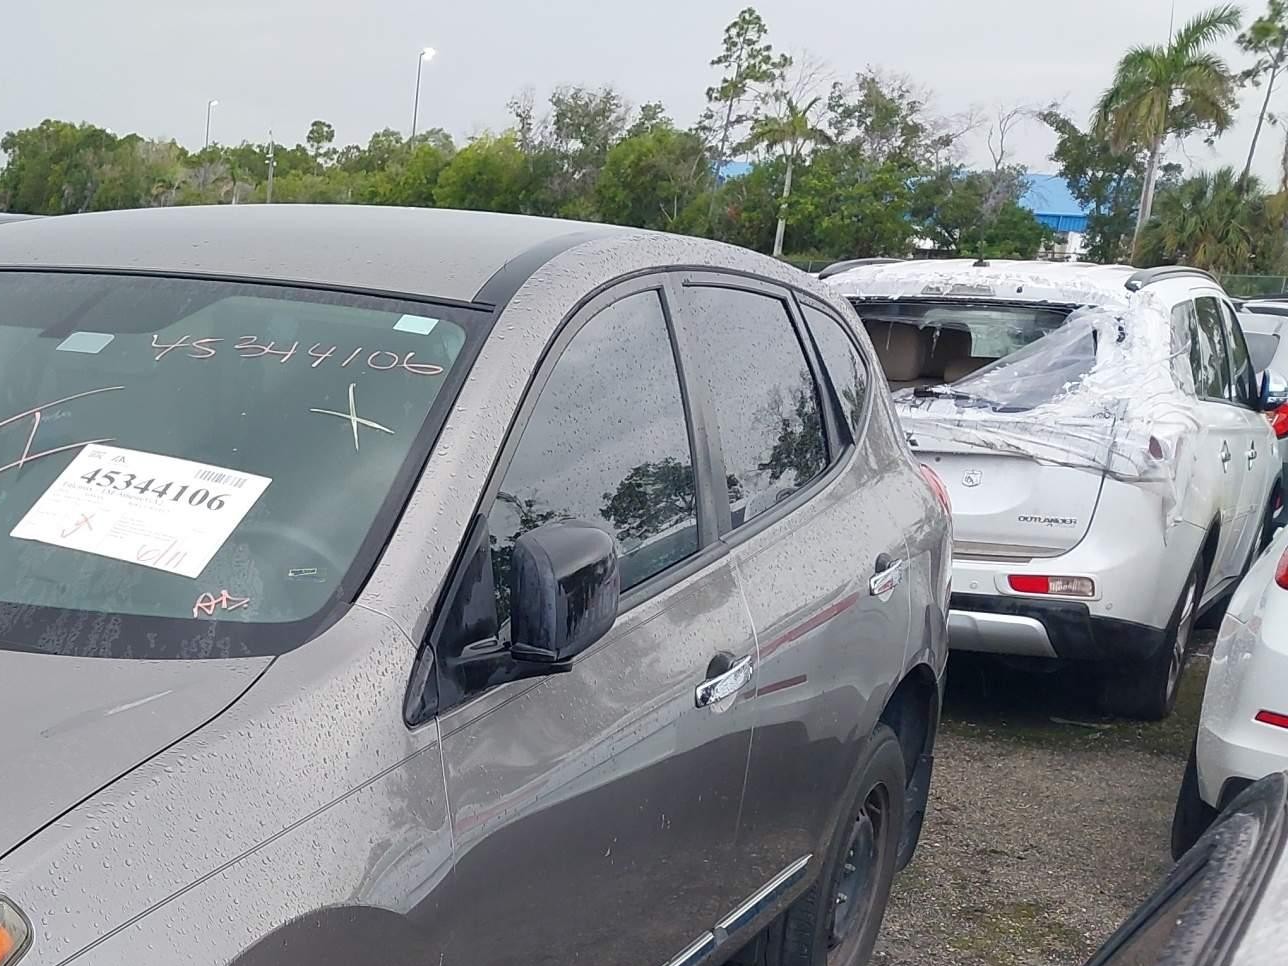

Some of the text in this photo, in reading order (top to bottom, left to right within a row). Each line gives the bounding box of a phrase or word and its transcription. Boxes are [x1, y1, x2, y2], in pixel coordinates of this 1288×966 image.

[151, 334, 444, 375] 45344106
[80, 468, 231, 511] 45344106
[1017, 515, 1078, 526] OUTLANDER
